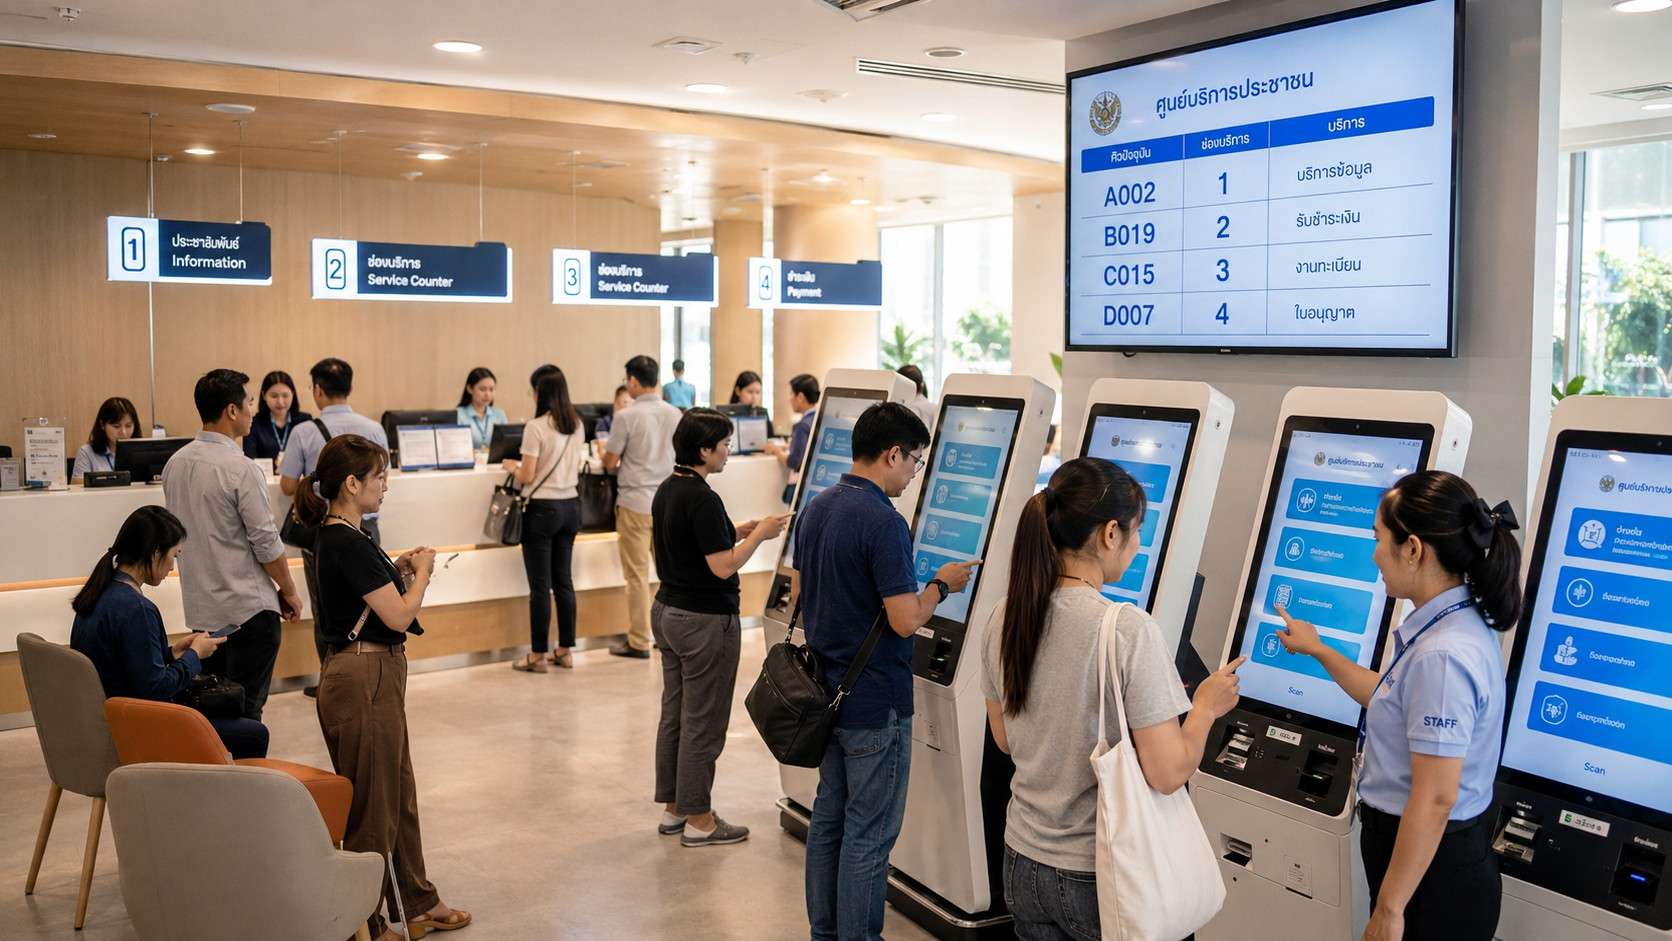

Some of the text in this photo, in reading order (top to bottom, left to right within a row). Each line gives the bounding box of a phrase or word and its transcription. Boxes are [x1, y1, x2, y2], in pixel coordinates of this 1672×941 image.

[1156, 71, 1314, 119] ศูนย์บริการประชาชน
[1328, 117, 1366, 132] บริการ
[1201, 134, 1250, 150] ช่องบริการ
[1297, 161, 1372, 181] บริการข้อมูล
[1218, 172, 1227, 195] 1
[1104, 181, 1156, 207] A002
[1216, 215, 1230, 239] 2
[1296, 210, 1361, 227] รับชำระเงิน
[1104, 222, 1155, 247] B019
[127, 238, 137, 261] 1
[172, 254, 247, 269] Information
[329, 258, 343, 280] 2
[1216, 259, 1230, 282] 3
[1295, 256, 1362, 274] งานทะเบียน
[367, 273, 454, 288] Service Counter
[567, 267, 578, 286] 3
[761, 274, 770, 291] 4
[1103, 263, 1155, 286] C015
[597, 280, 669, 294] Service Counter
[1103, 304, 1155, 326] D007
[1215, 303, 1229, 325] 4
[1294, 303, 1355, 323] ใบอนุญาต
[1288, 686, 1304, 697] Scan
[1423, 716, 1458, 729] STAFF
[1584, 761, 1606, 776] Scan
